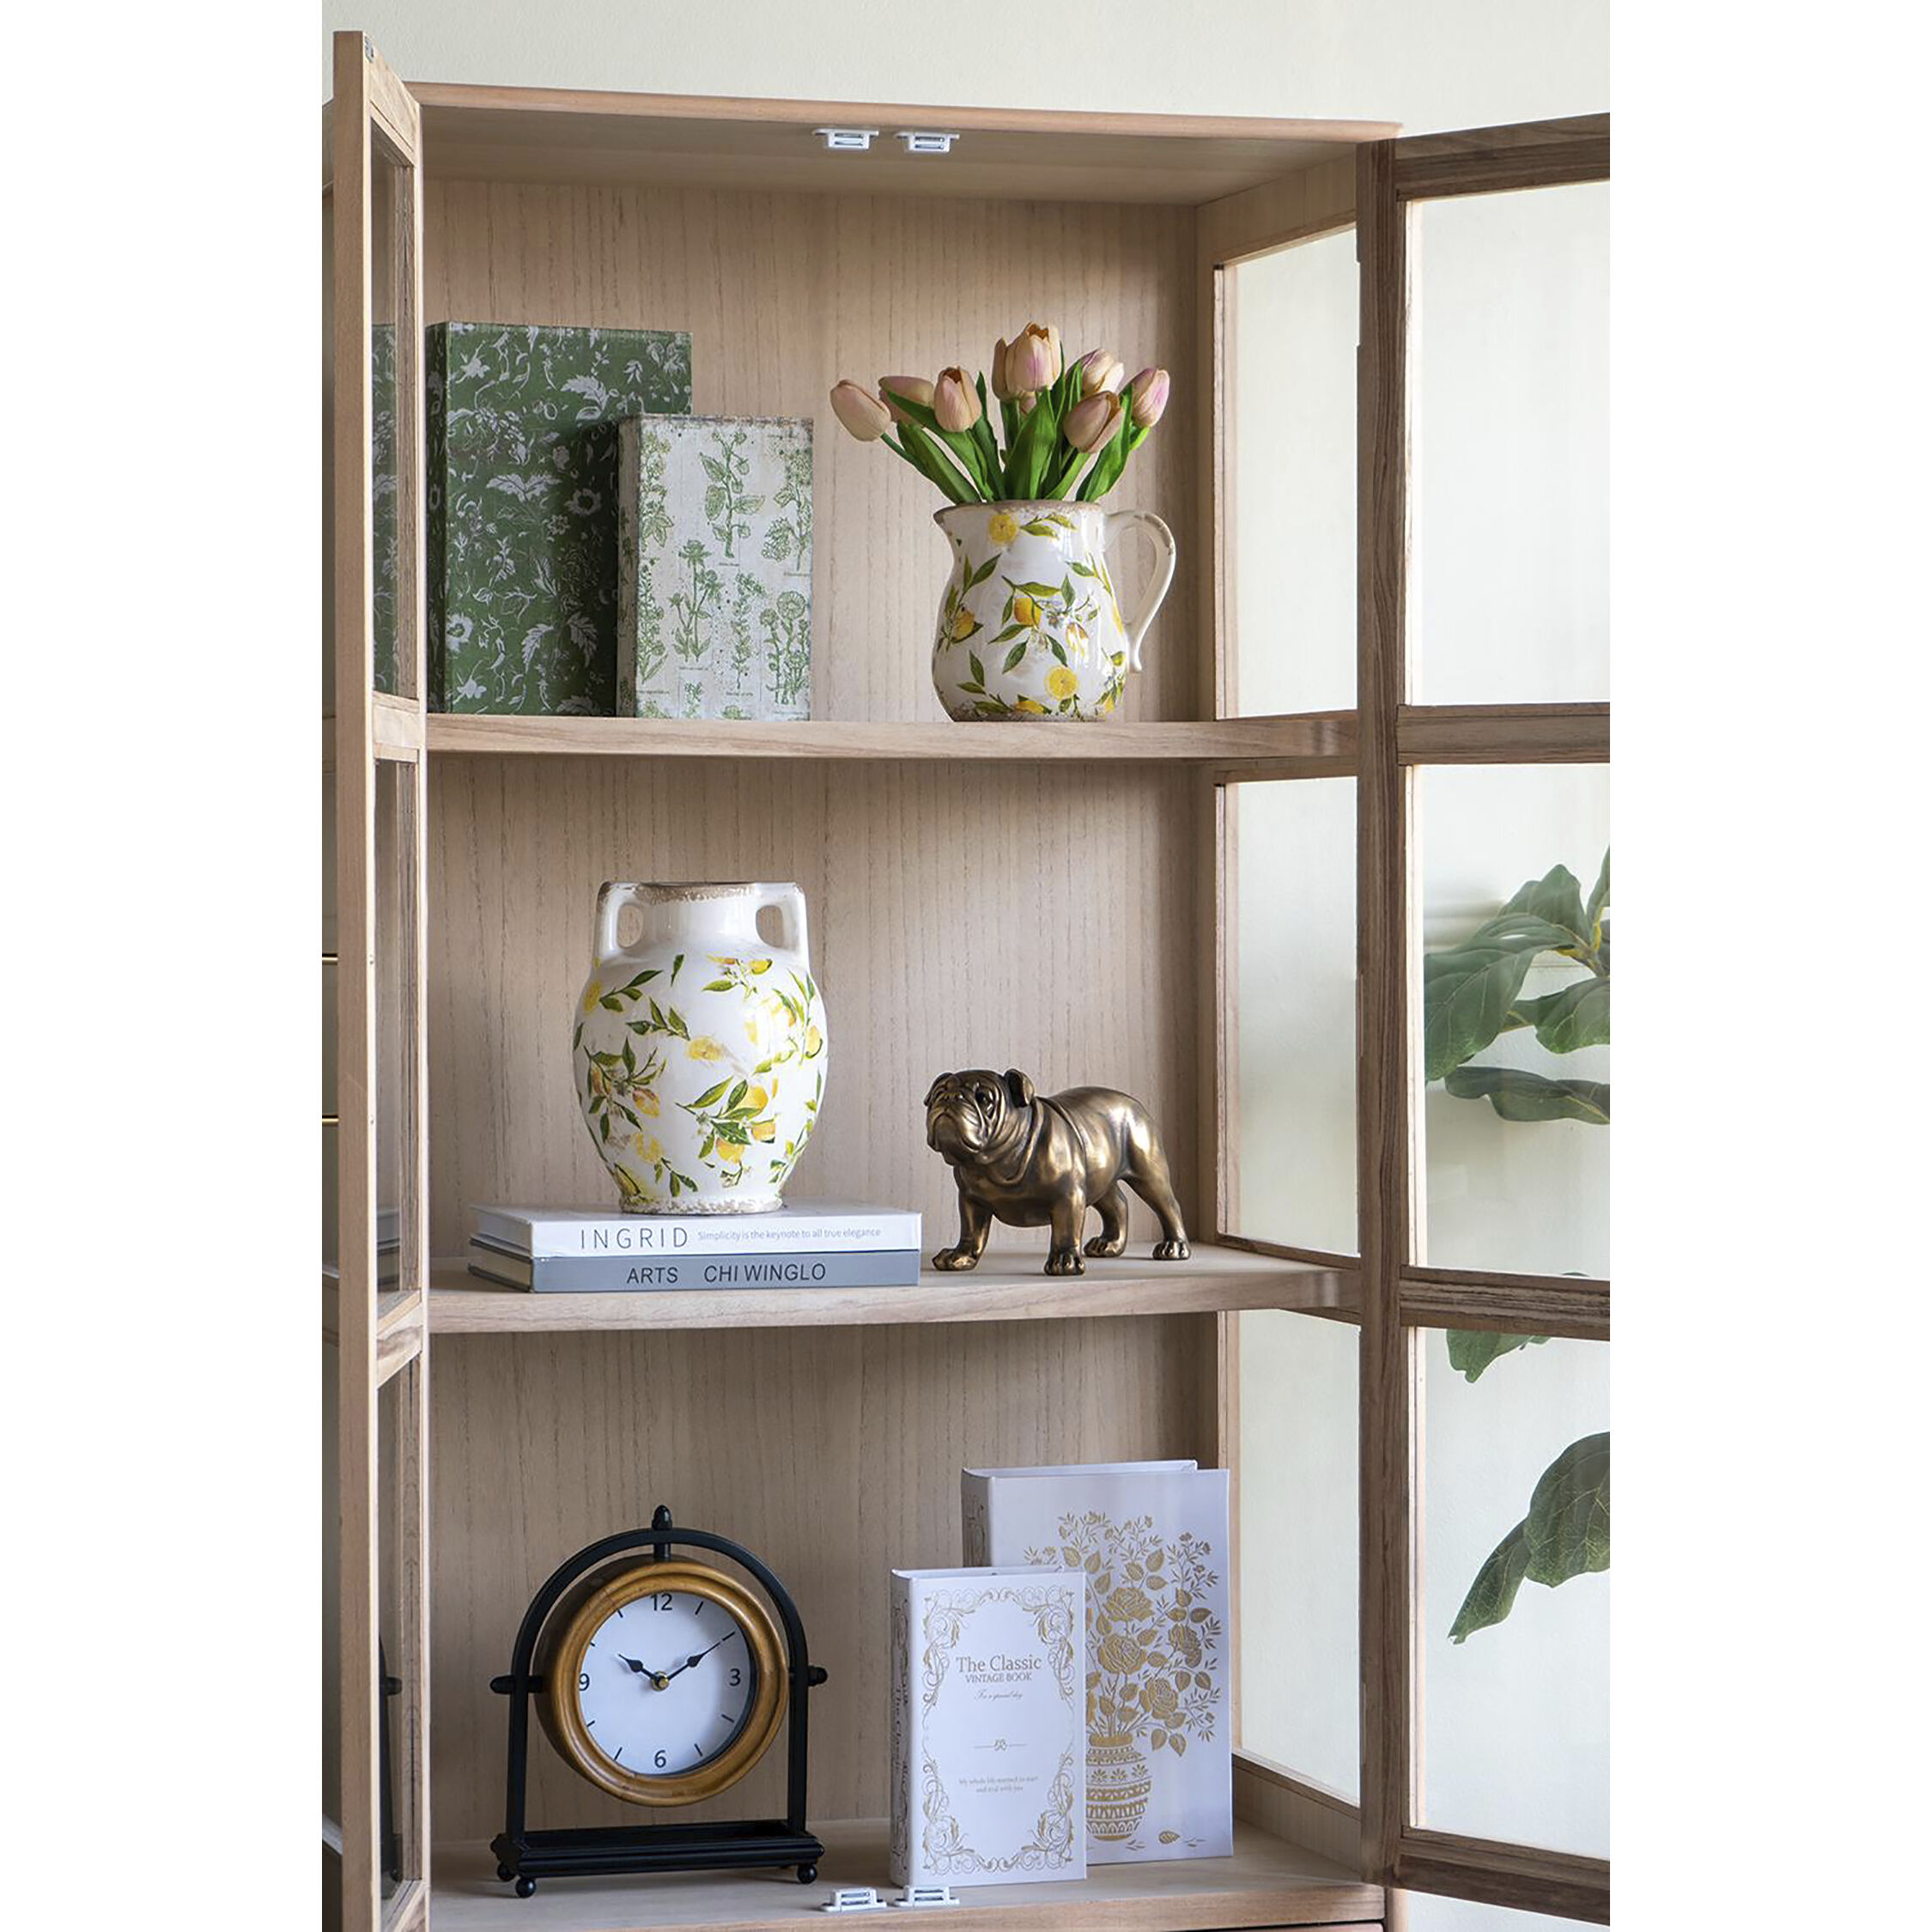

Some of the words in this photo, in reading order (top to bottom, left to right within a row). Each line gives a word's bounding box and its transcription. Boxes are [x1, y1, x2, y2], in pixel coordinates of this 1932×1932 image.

[580, 1227, 688, 1249] INGRID
[697, 1229, 740, 1243] Simplicity
[742, 1229, 750, 1240] is
[750, 1229, 765, 1240] the
[766, 1228, 800, 1242] keynote
[802, 1228, 811, 1238] to
[811, 1227, 823, 1238] all
[823, 1228, 841, 1238] true
[843, 1227, 881, 1241] elegance
[626, 1267, 678, 1285] ARTS
[703, 1265, 738, 1283] CHI
[744, 1263, 826, 1282] WINGLO
[650, 1594, 673, 1612] 12
[955, 1656, 986, 1673] The
[989, 1654, 1042, 1672] Classic
[579, 1673, 590, 1691] 9
[729, 1668, 741, 1686] 3
[964, 1673, 1005, 1683] VINTAGE
[1005, 1671, 1032, 1682] BOOK
[653, 1749, 666, 1768] 6
